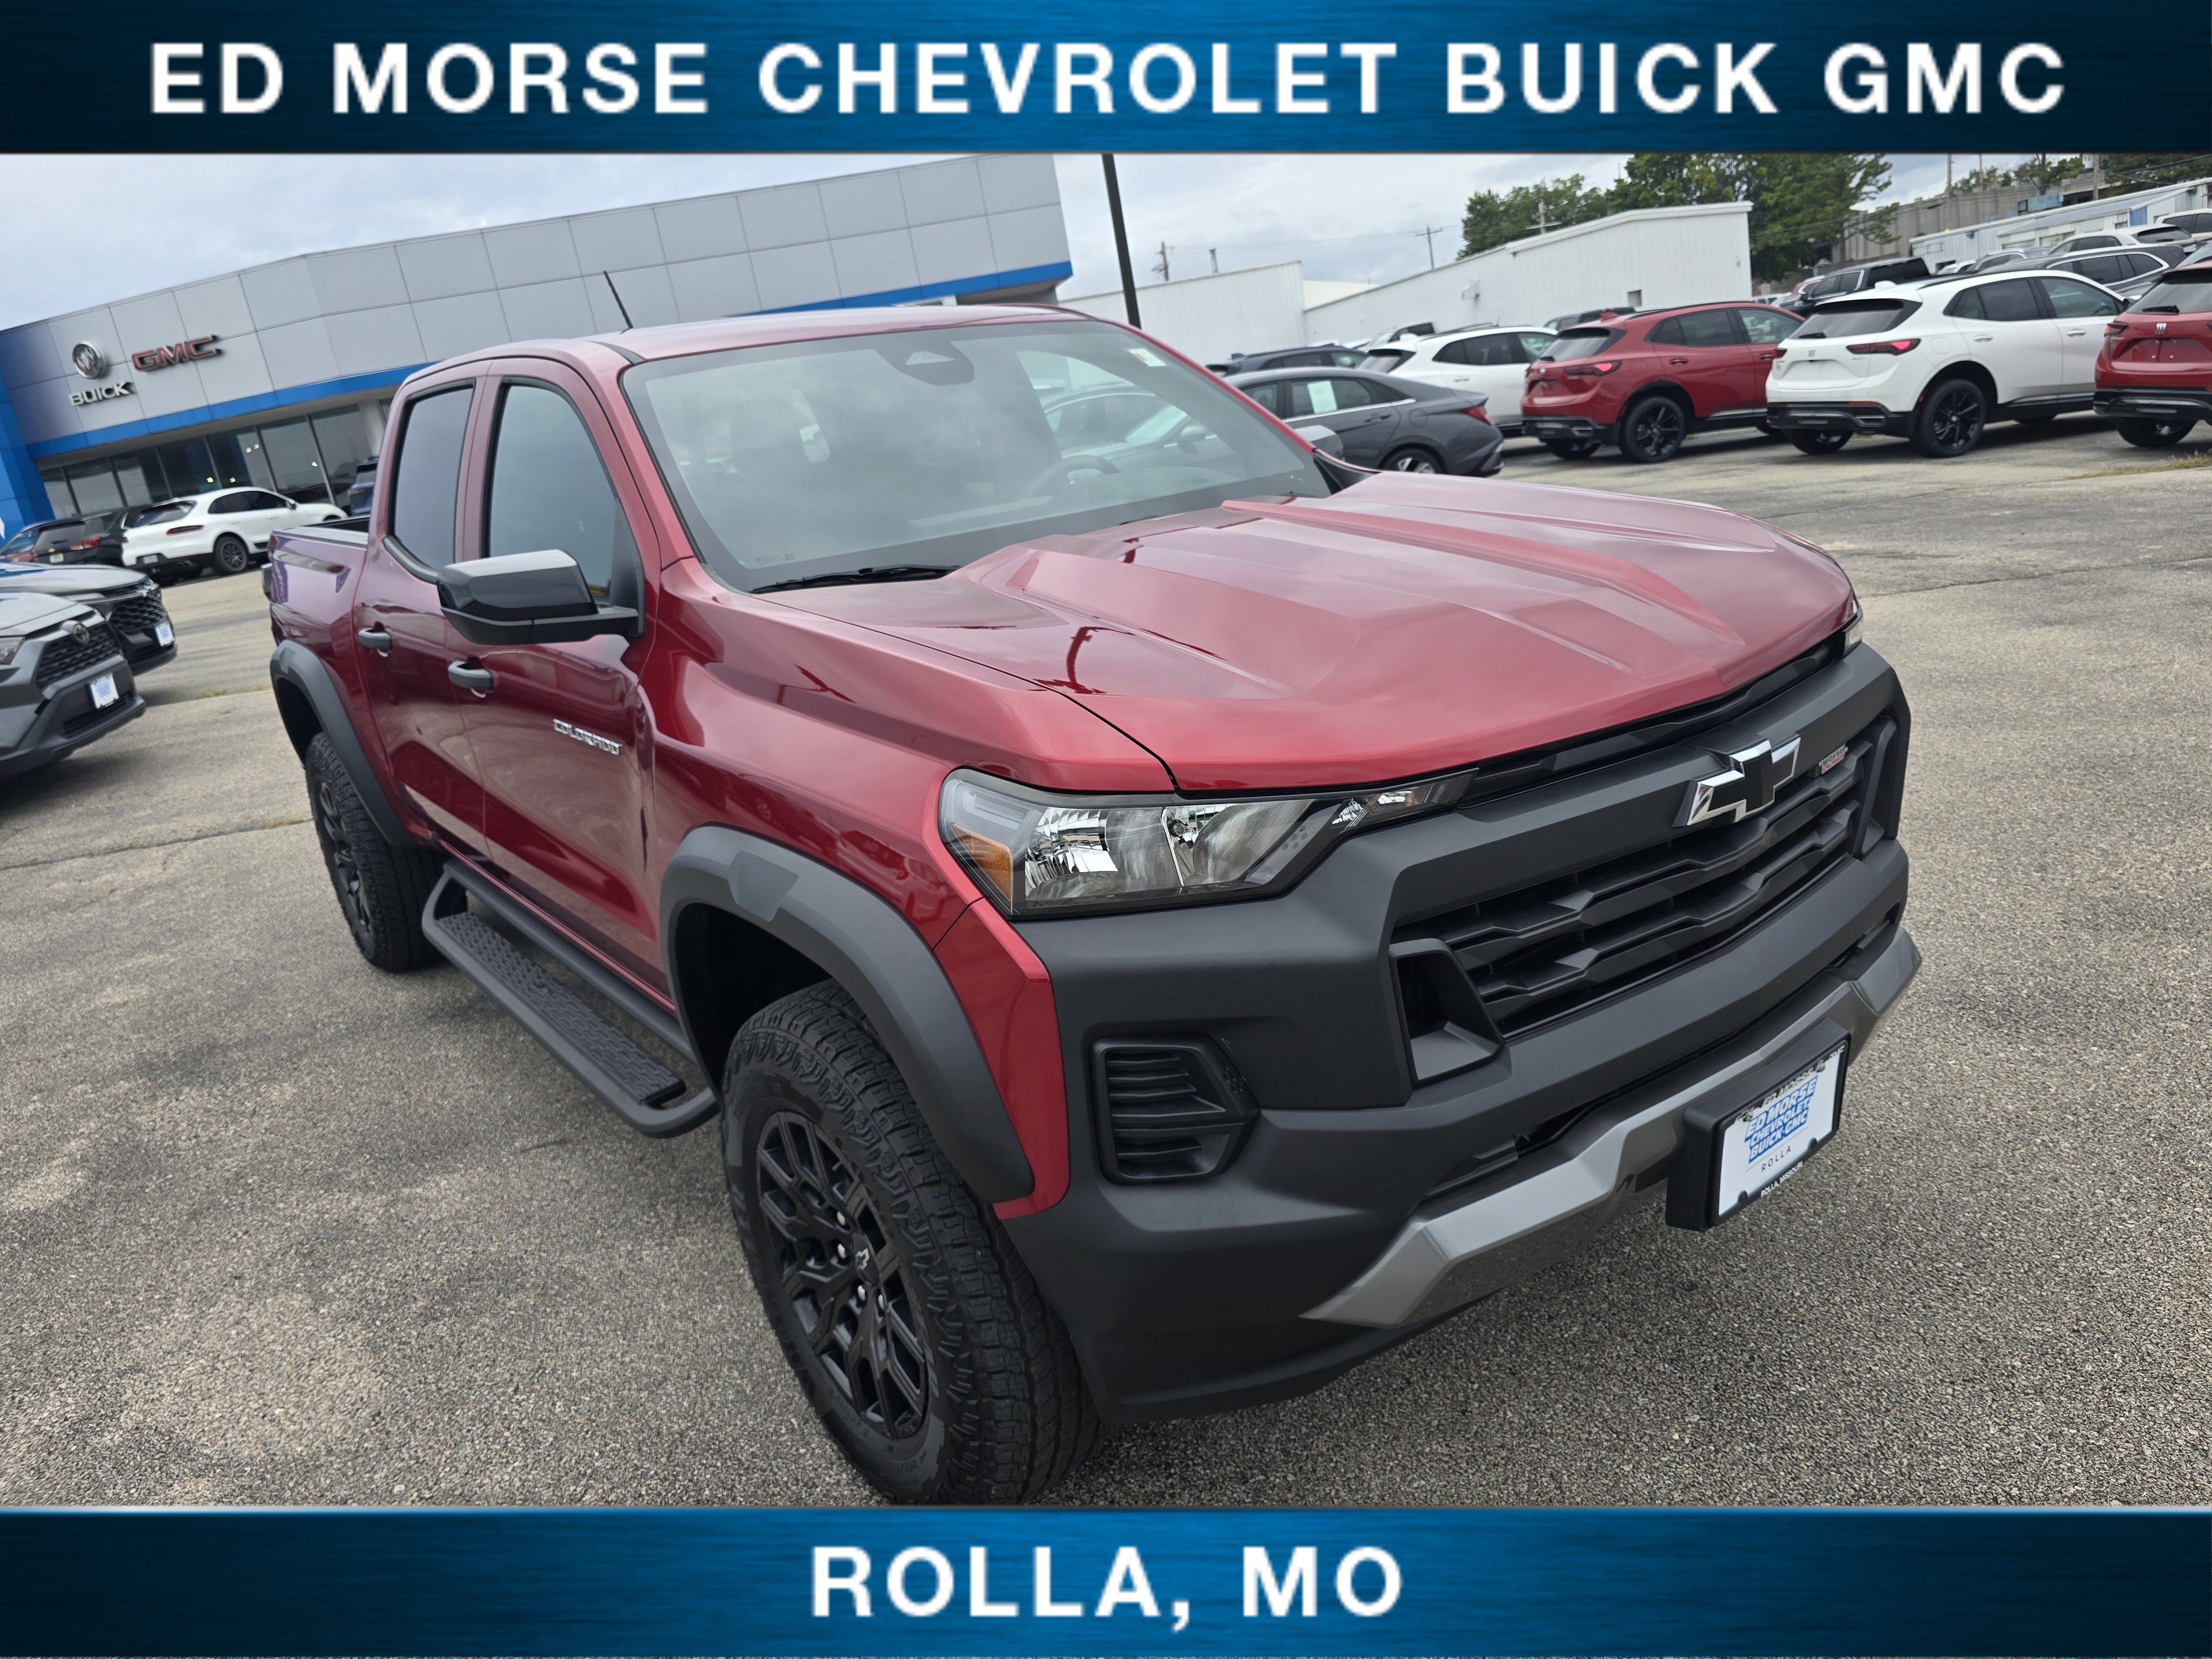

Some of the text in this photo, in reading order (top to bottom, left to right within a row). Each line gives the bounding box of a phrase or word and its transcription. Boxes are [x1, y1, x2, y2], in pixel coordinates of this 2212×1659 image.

[131, 335, 219, 372] GMC
[69, 380, 132, 406] BUICK
[552, 718, 623, 756] COLORADO
[1745, 1075, 1818, 1141] ED MORSE
[1750, 1096, 1810, 1149] CHEVROLET
[1748, 1125, 1784, 1164] BUICK
[1783, 1108, 1809, 1138] GMC
[1761, 1145, 1792, 1173] ROLLA
